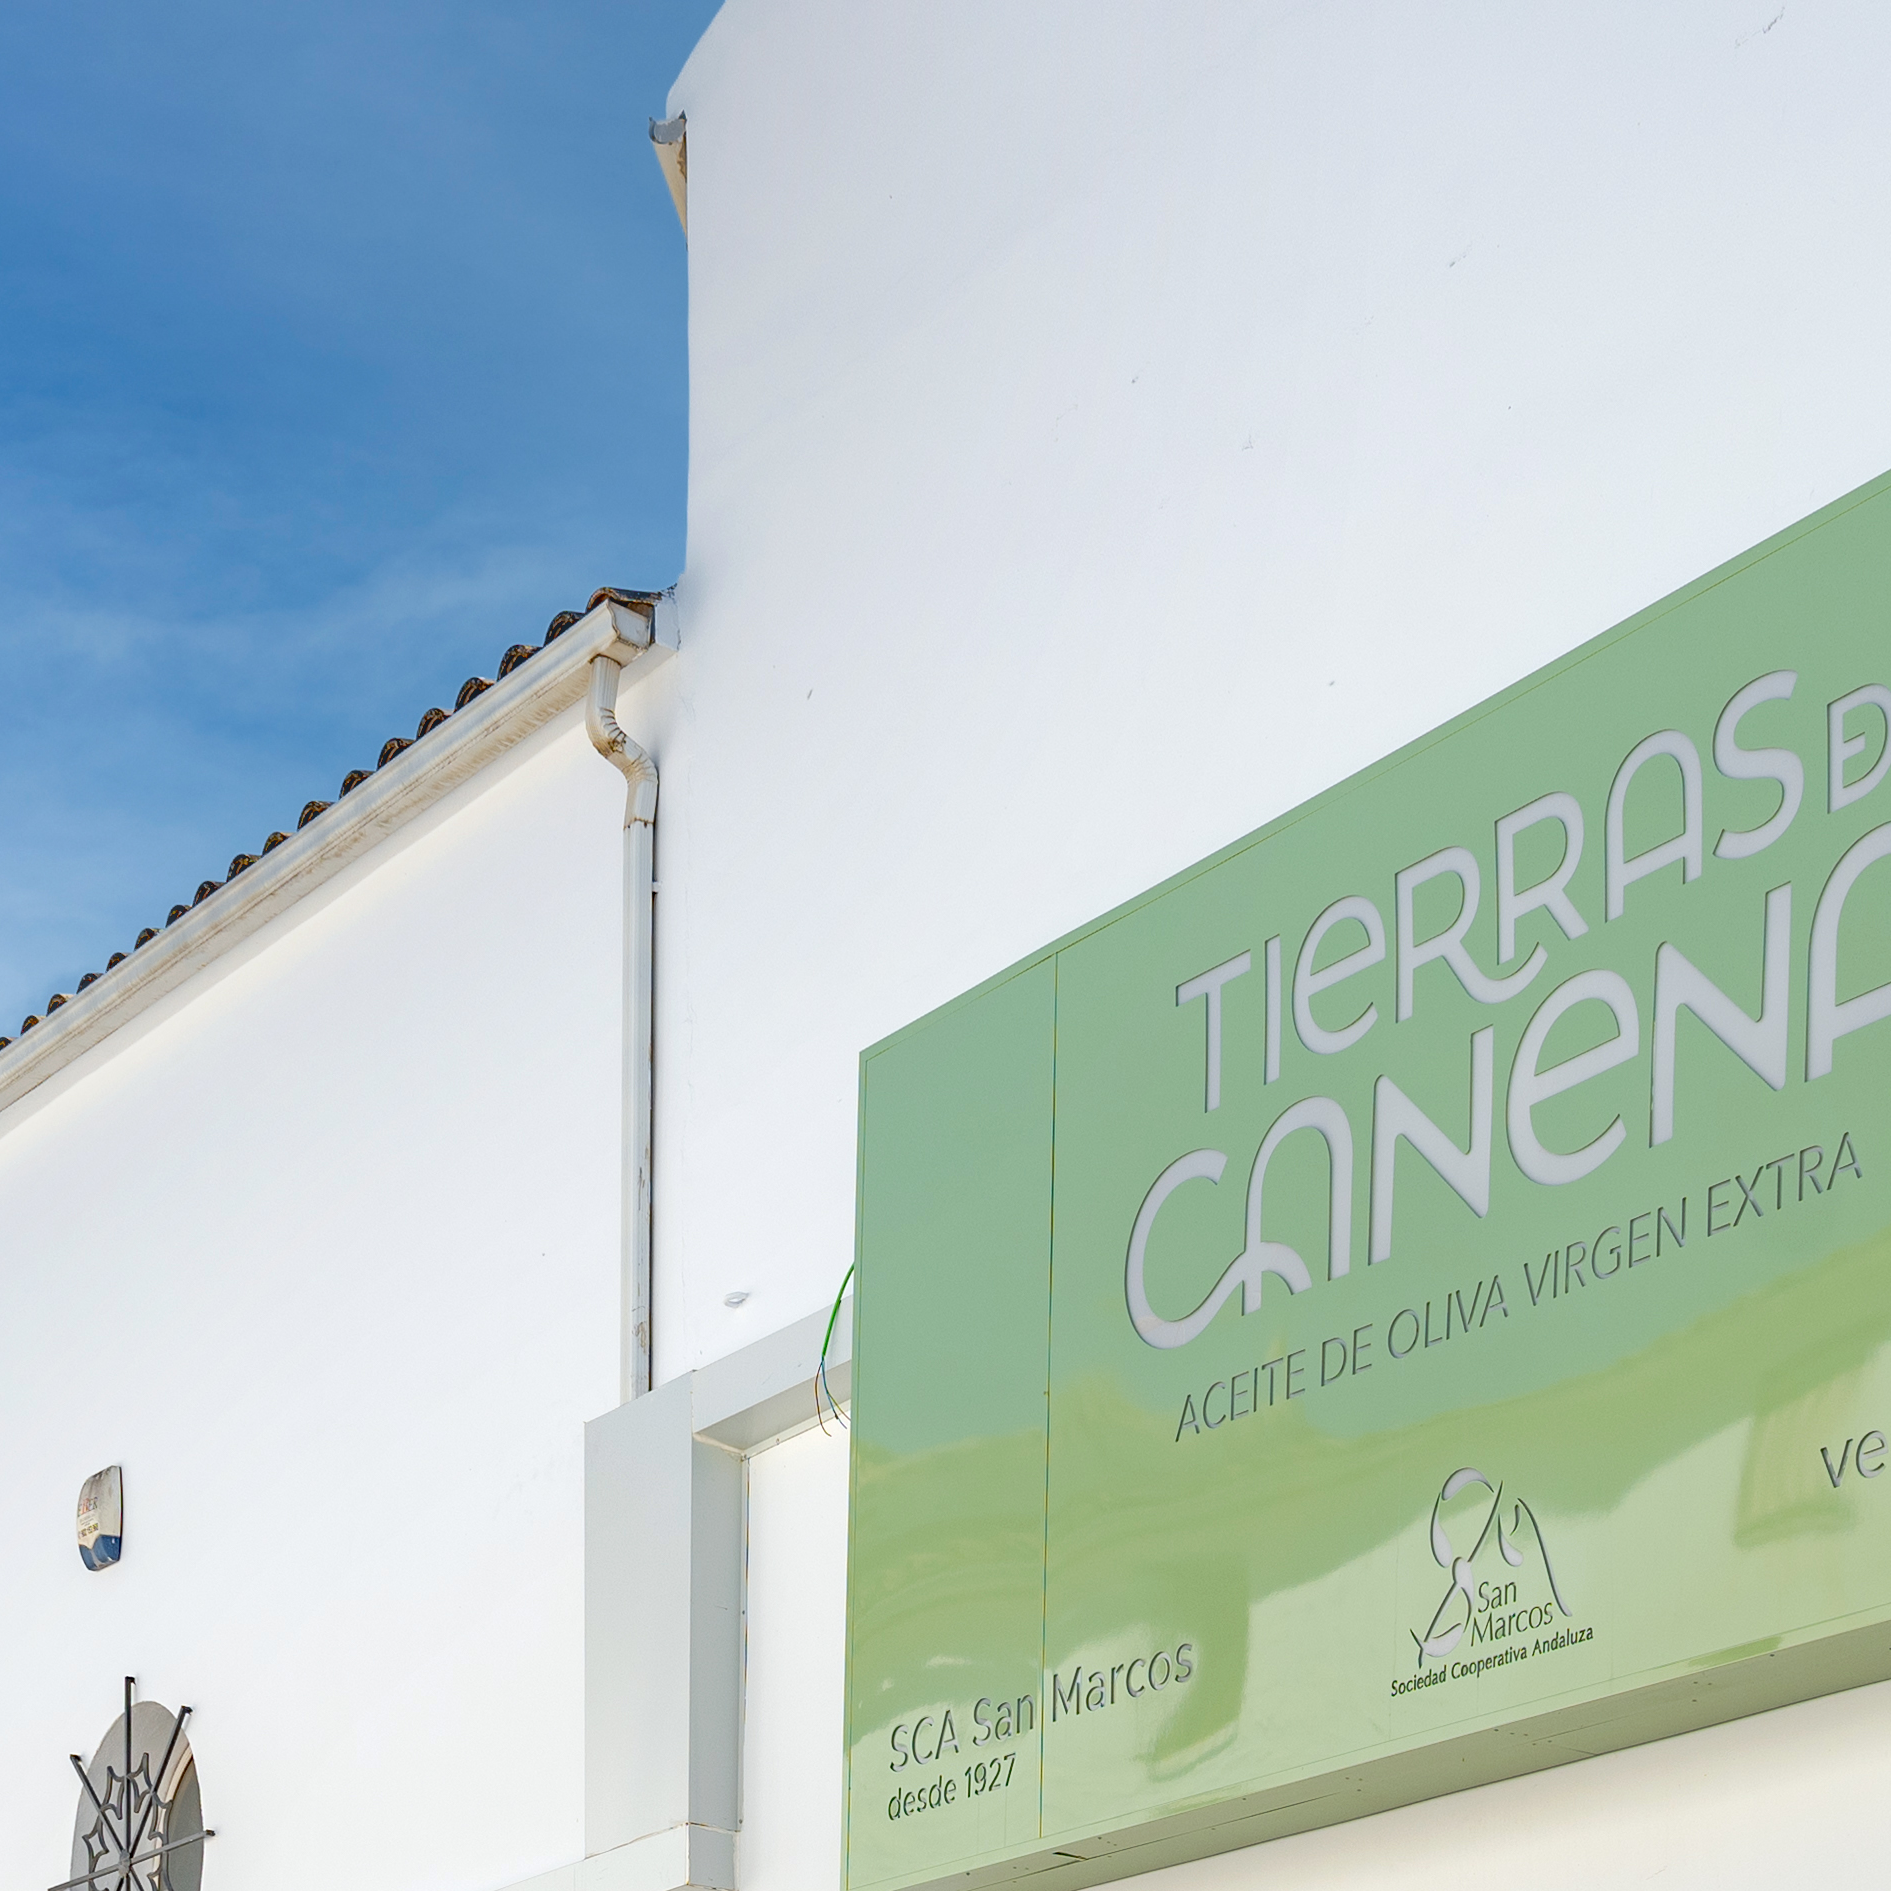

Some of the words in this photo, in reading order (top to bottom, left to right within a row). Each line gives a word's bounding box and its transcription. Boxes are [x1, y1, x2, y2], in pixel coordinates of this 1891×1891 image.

[1175, 1348, 1307, 1443] ACEITE
[1320, 1322, 1374, 1387] DE
[1386, 1274, 1510, 1360] OLIVA
[1522, 1196, 1688, 1307] VIRGEN
[1706, 1131, 1864, 1238] EXTRA
[1470, 1602, 1555, 1648] Marcos
[1477, 1580, 1518, 1614] San
[1390, 1664, 1447, 1698] Sociedad
[1451, 1645, 1528, 1679] Cooperativa
[1531, 1625, 1595, 1657] Andaluza
[889, 1708, 960, 1773] SCA
[972, 1692, 1035, 1748] San
[1051, 1642, 1194, 1723] Marcos
[887, 1774, 958, 1822] desde
[964, 1751, 1017, 1799] 1927
